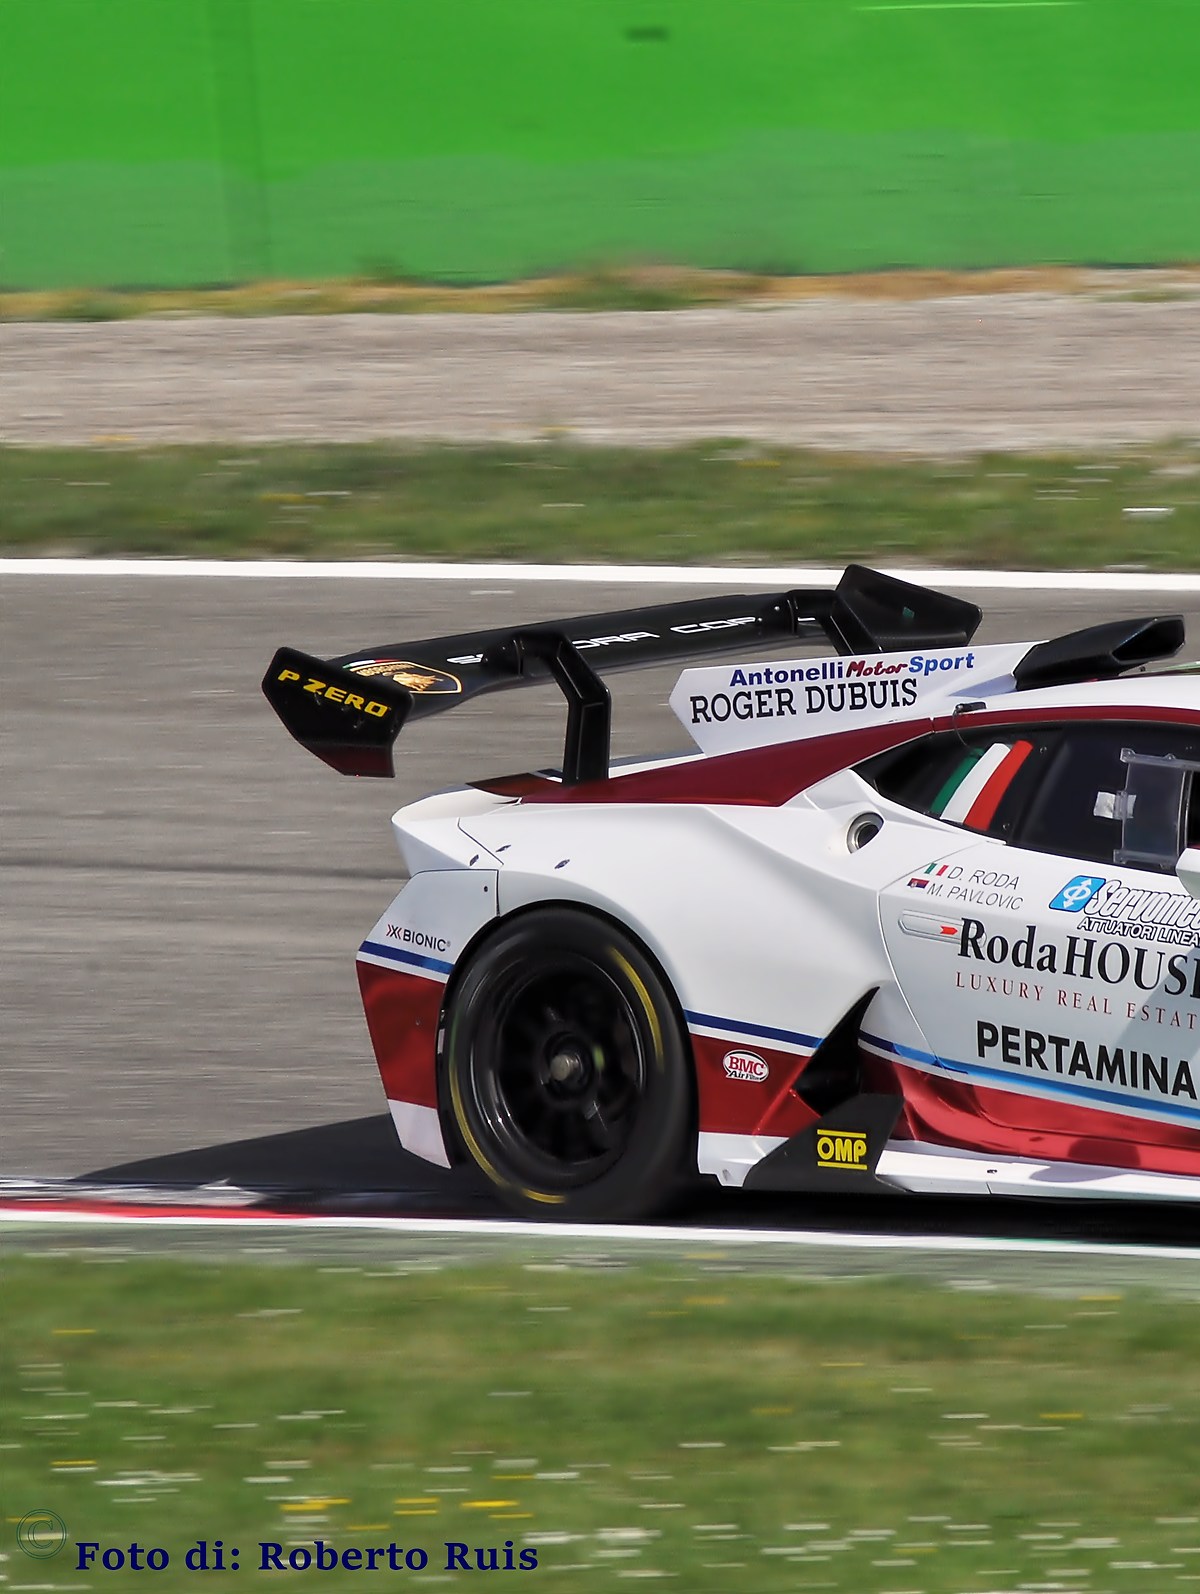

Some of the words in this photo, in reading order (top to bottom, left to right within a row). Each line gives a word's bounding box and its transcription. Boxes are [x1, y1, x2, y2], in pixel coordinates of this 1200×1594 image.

[729, 662, 843, 687] Antonelli
[277, 669, 300, 682] P
[303, 678, 389, 718] ZERO
[690, 688, 796, 723] ROGER
[806, 678, 917, 713] DUBUIS
[947, 866, 962, 880] D.
[968, 869, 1019, 890] RODA
[927, 883, 941, 897] M.
[947, 886, 1023, 910] PAVLOVIC
[1077, 916, 1158, 942] ATTUATORI
[955, 971, 1044, 1001] LUXURY
[1057, 989, 1112, 1014] REAL
[728, 1056, 764, 1076] BMC
[976, 1020, 1198, 1100] PERTAMINA
[817, 1135, 866, 1163] OMP
